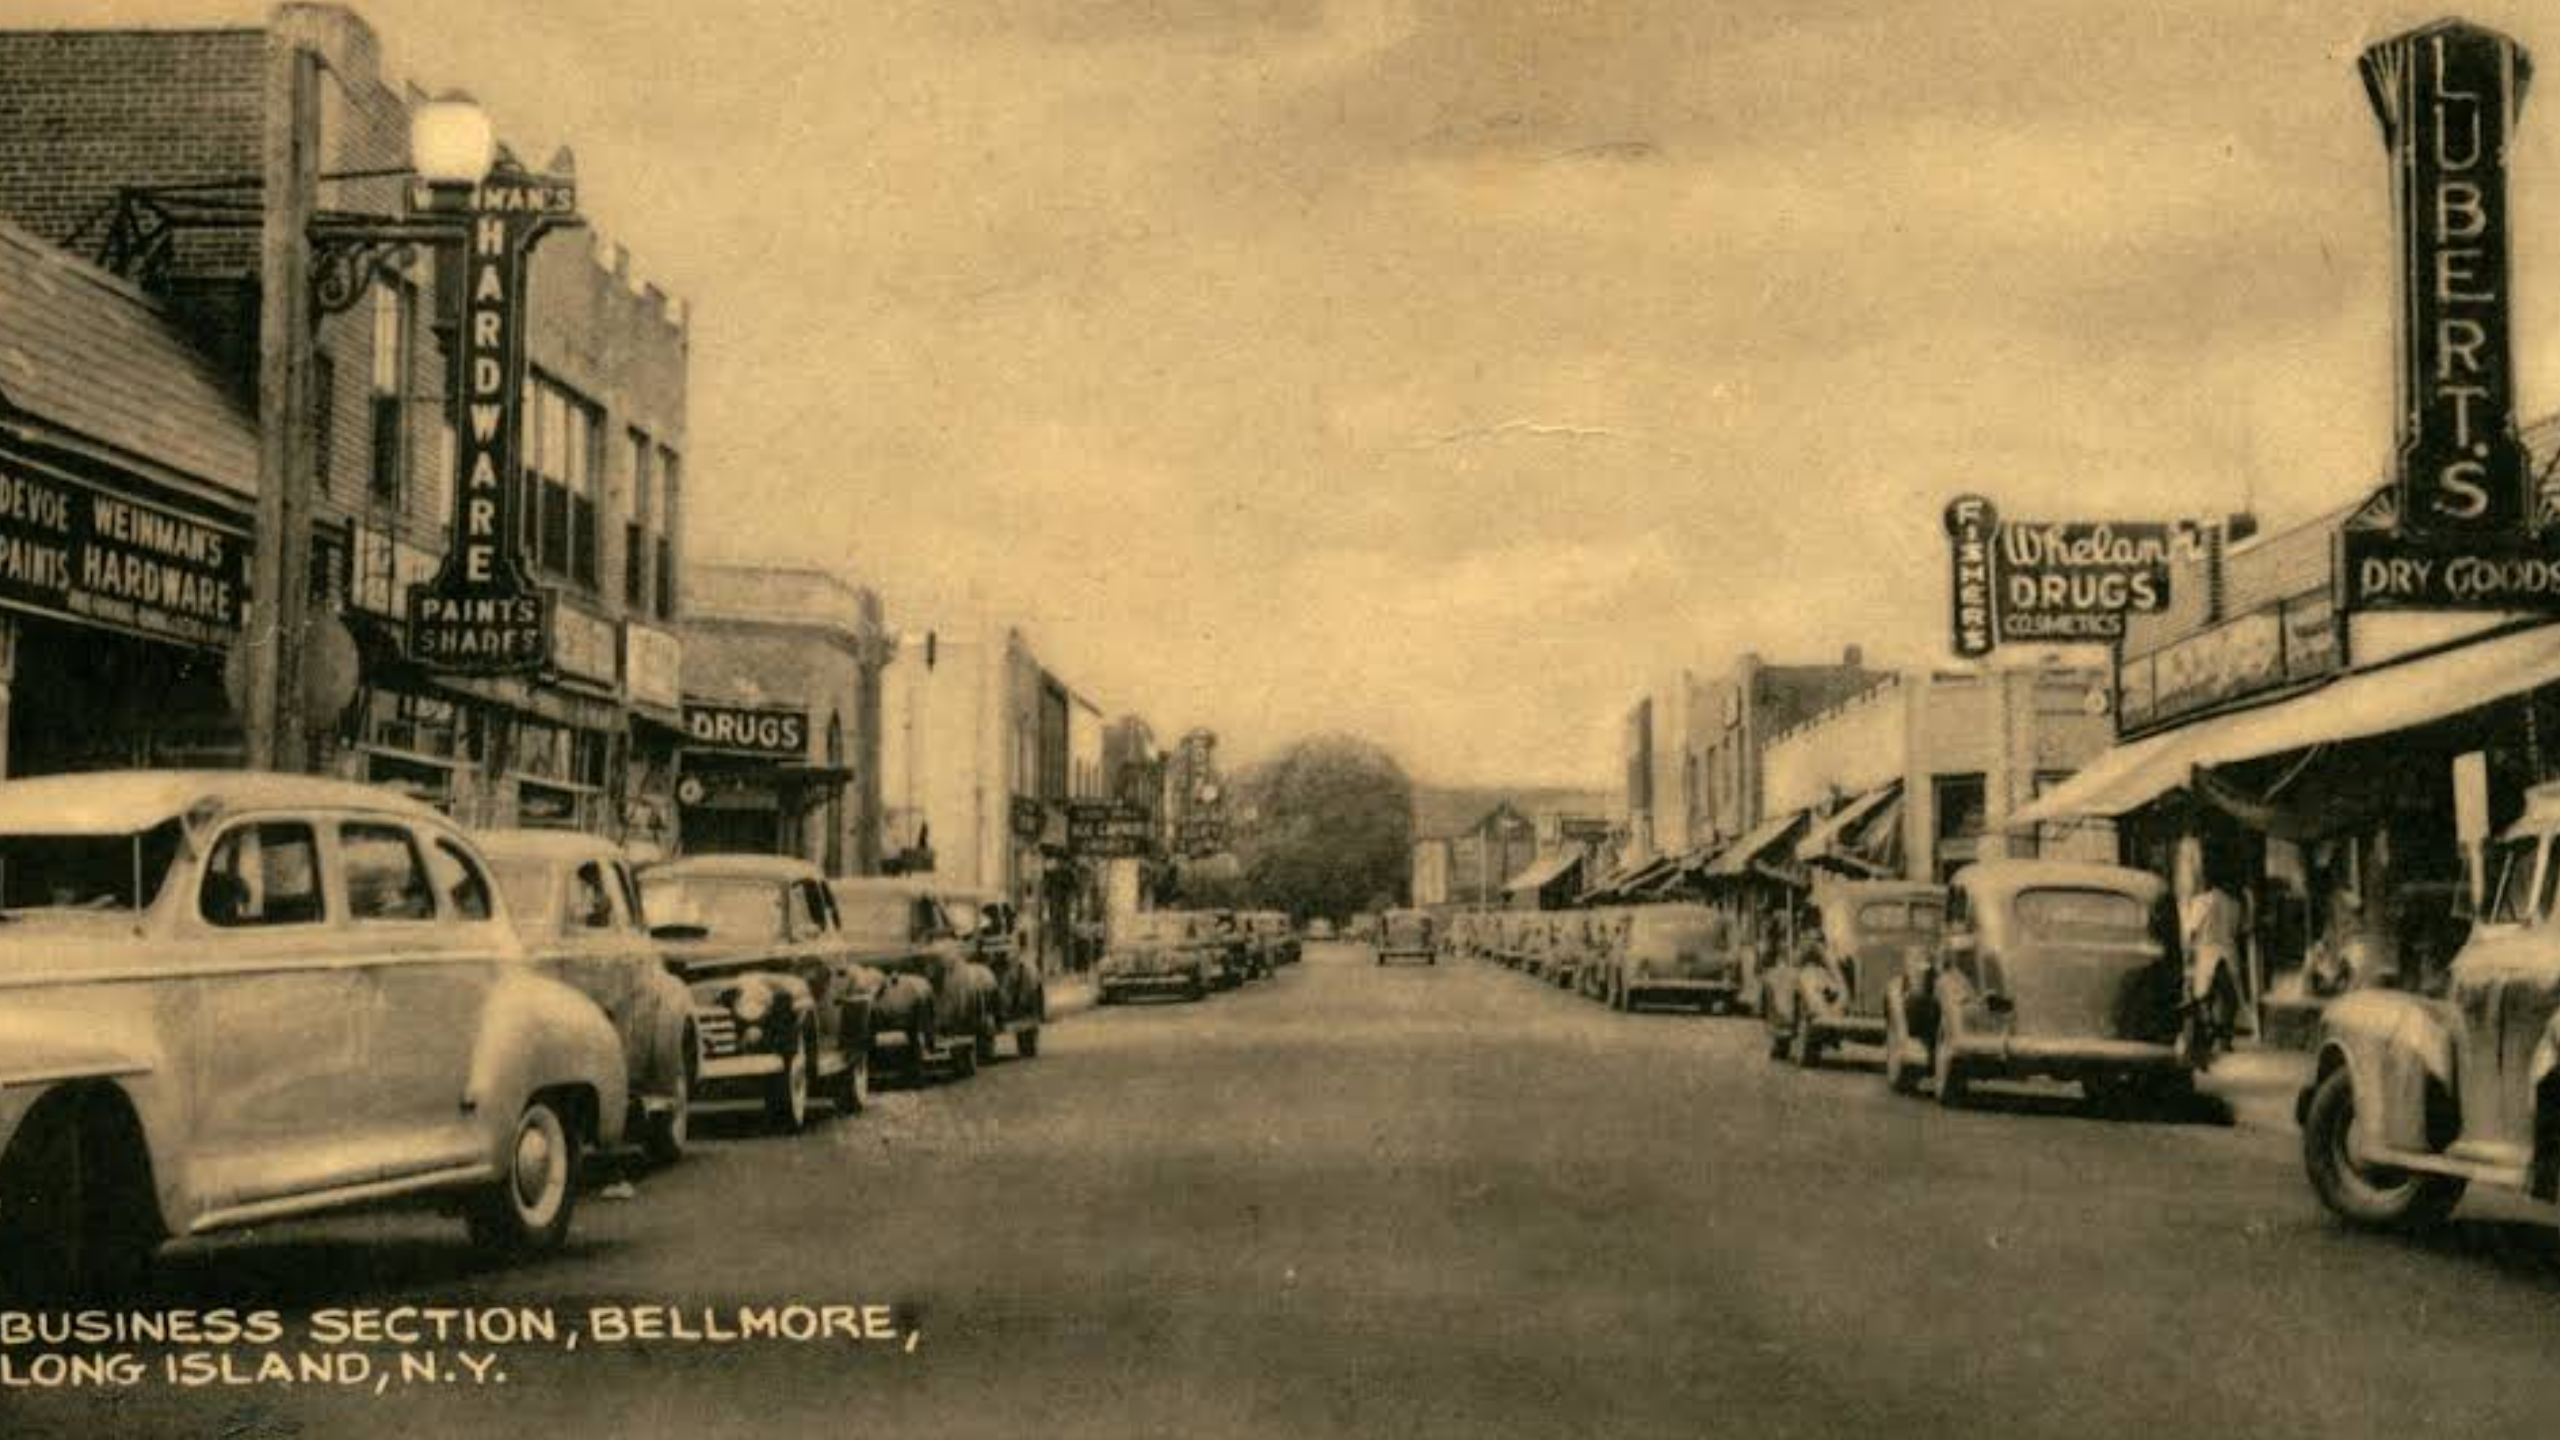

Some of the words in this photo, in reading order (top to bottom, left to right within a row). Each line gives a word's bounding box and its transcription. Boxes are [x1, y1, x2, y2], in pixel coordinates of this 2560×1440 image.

[467, 217, 503, 582] HARDWARE
[93, 496, 224, 568] WEINMAN'S
[83, 542, 232, 622] HARDWARE
[2010, 572, 2156, 610] DRUGS
[2361, 558, 2431, 592] DRY
[421, 599, 537, 622] PAINTS
[2004, 613, 2122, 636] COSMETICS
[419, 628, 541, 653] SHADES
[691, 711, 801, 749] DRUGS
